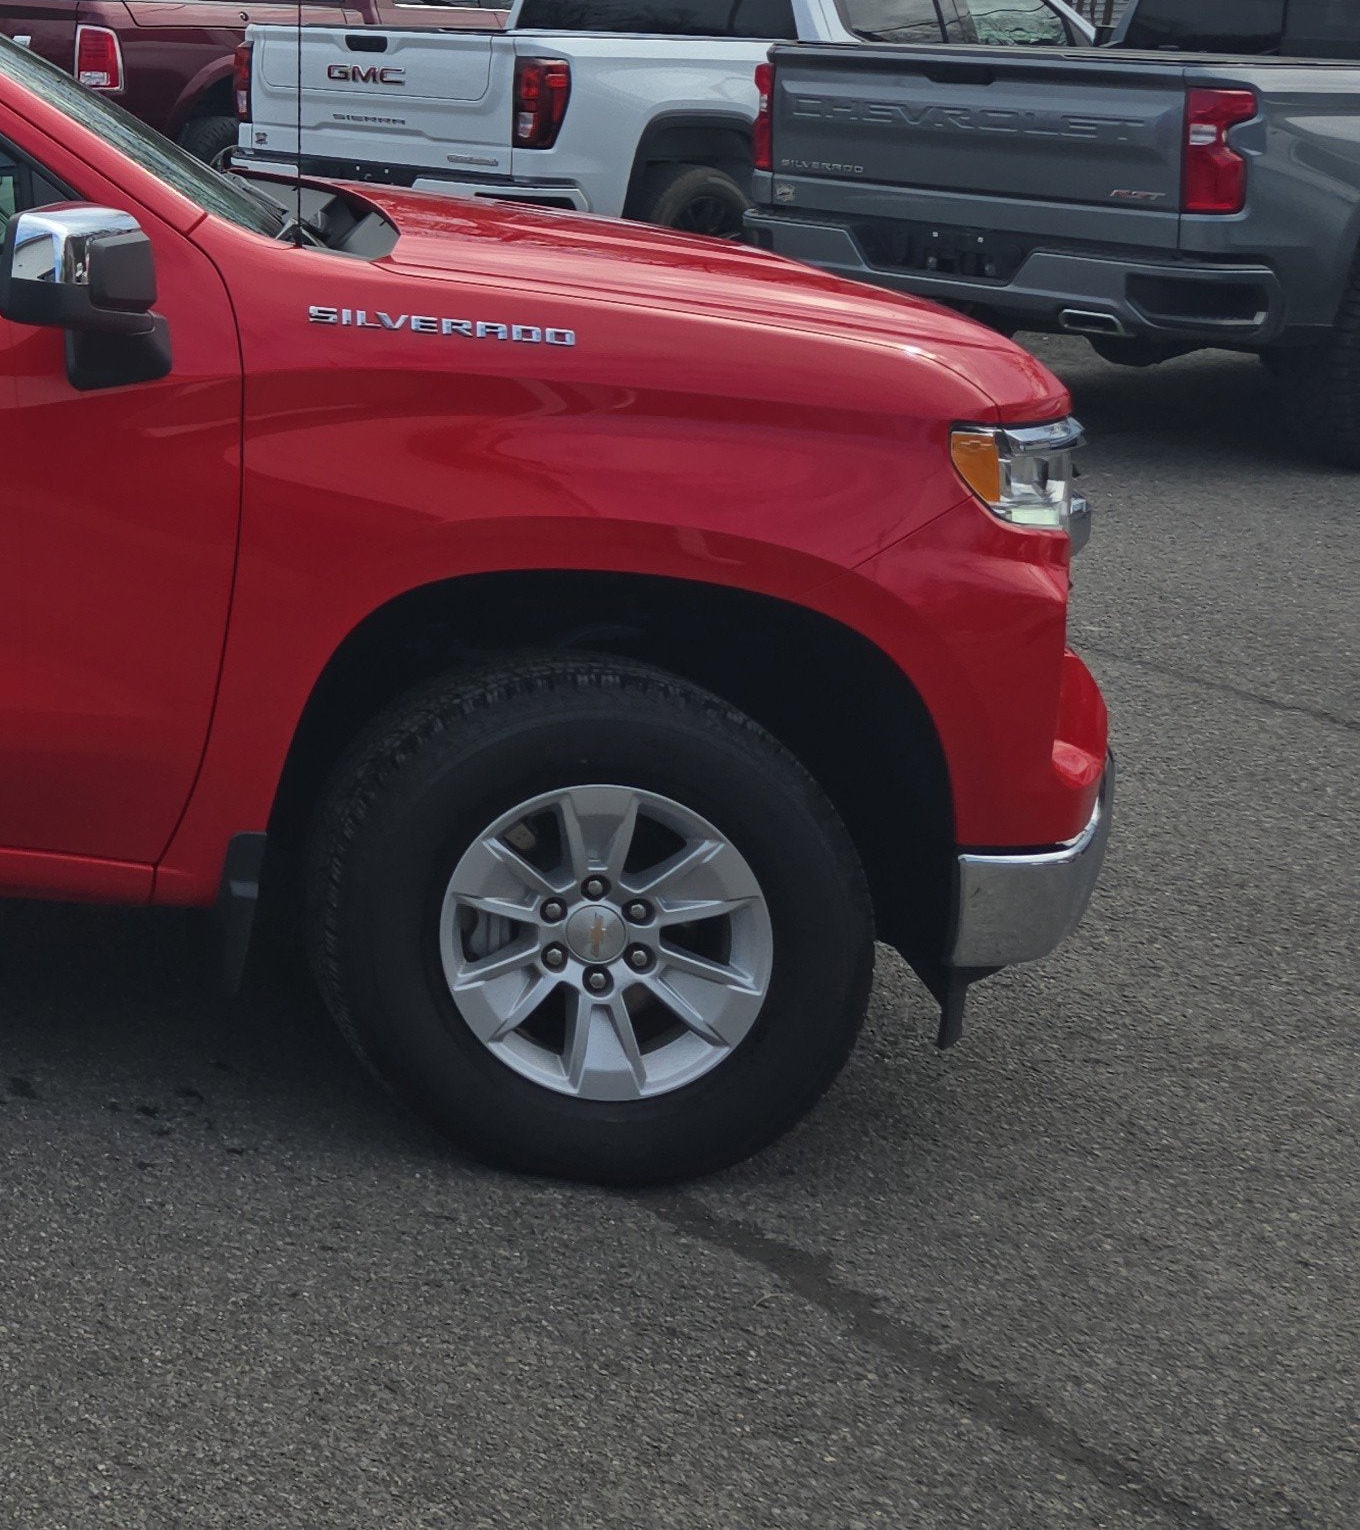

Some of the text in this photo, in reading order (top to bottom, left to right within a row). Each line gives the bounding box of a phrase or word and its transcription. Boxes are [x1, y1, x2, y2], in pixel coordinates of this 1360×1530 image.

[327, 64, 406, 86] GMC
[333, 113, 406, 126] SIERRA
[792, 95, 1147, 142] CHEVROLET
[781, 158, 865, 174] SILVERADO
[308, 304, 576, 347] SILVERADO
